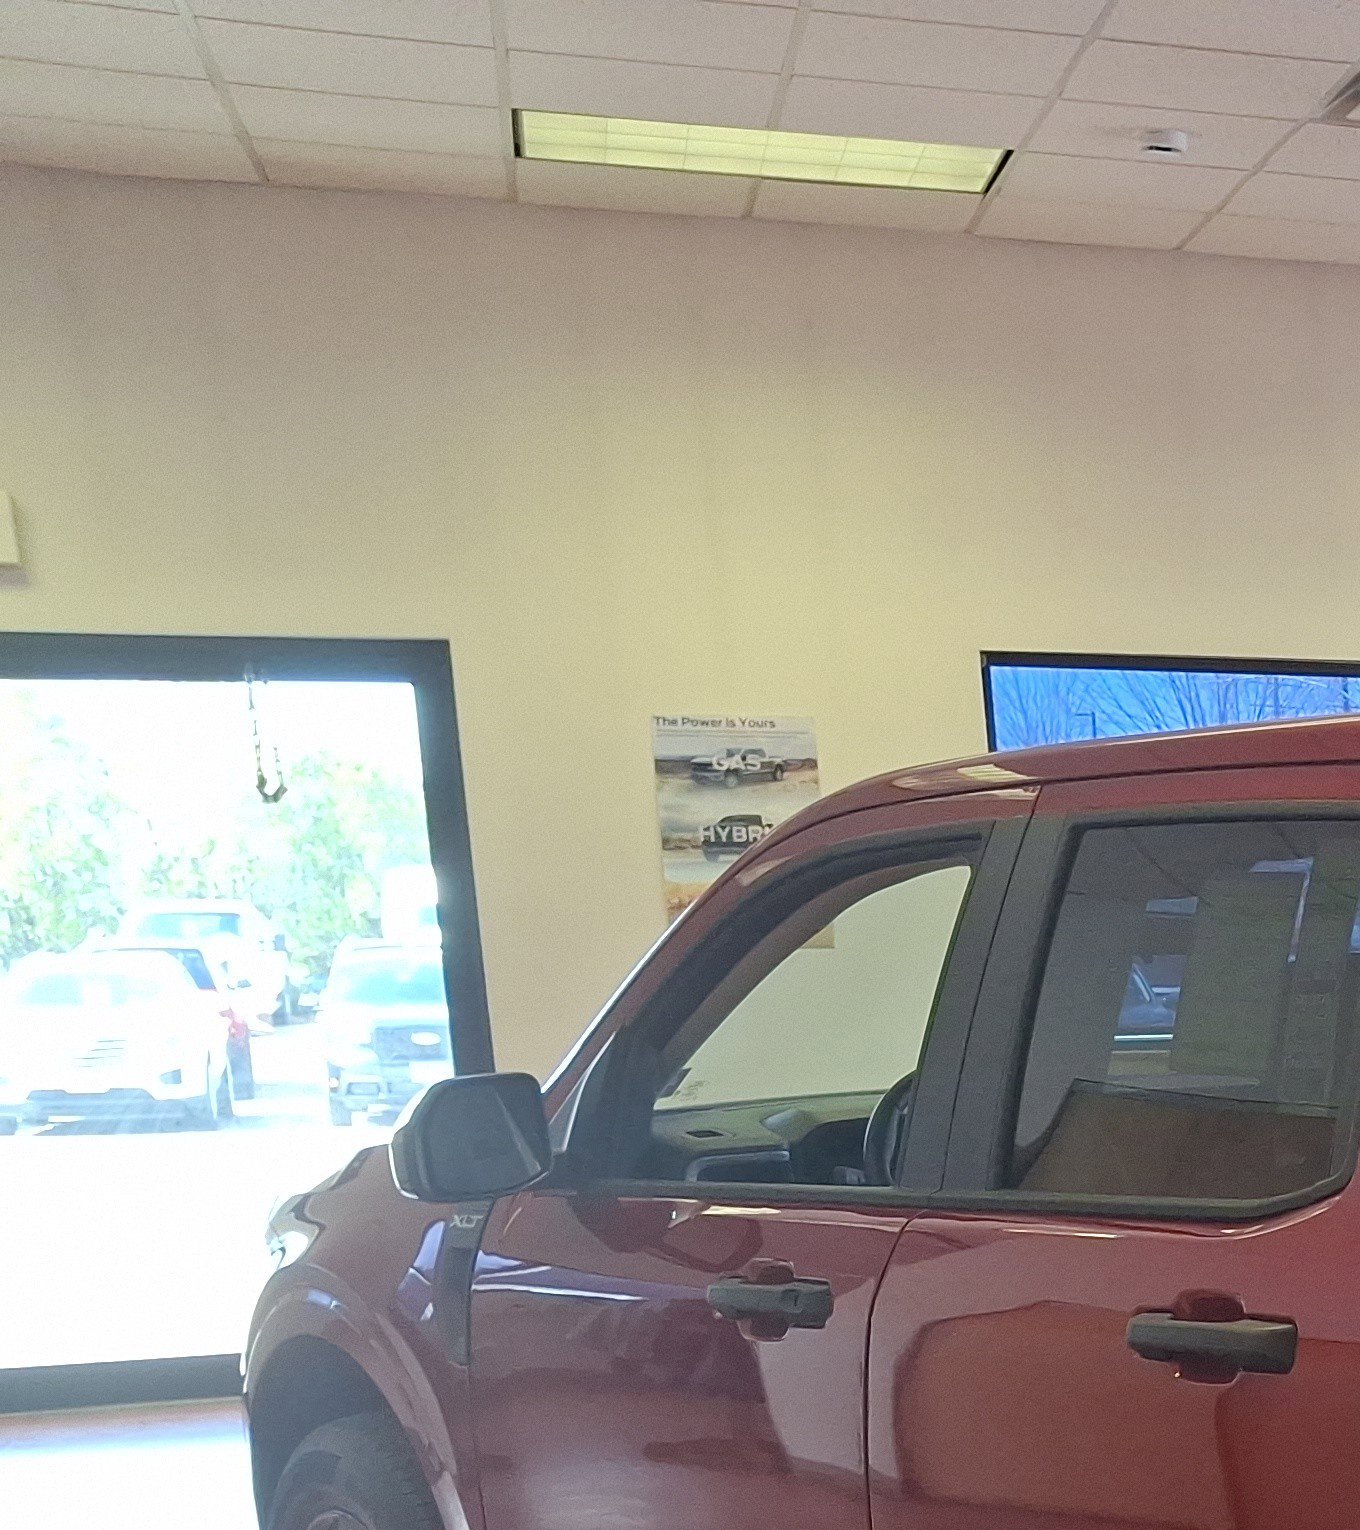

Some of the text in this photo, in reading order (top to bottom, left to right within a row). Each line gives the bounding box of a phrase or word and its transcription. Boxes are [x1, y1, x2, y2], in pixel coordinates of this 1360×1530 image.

[654, 716, 678, 727] The
[681, 717, 722, 727] Power
[739, 717, 776, 729] Yours
[712, 754, 761, 771] GAS
[449, 1214, 484, 1228] XLT
